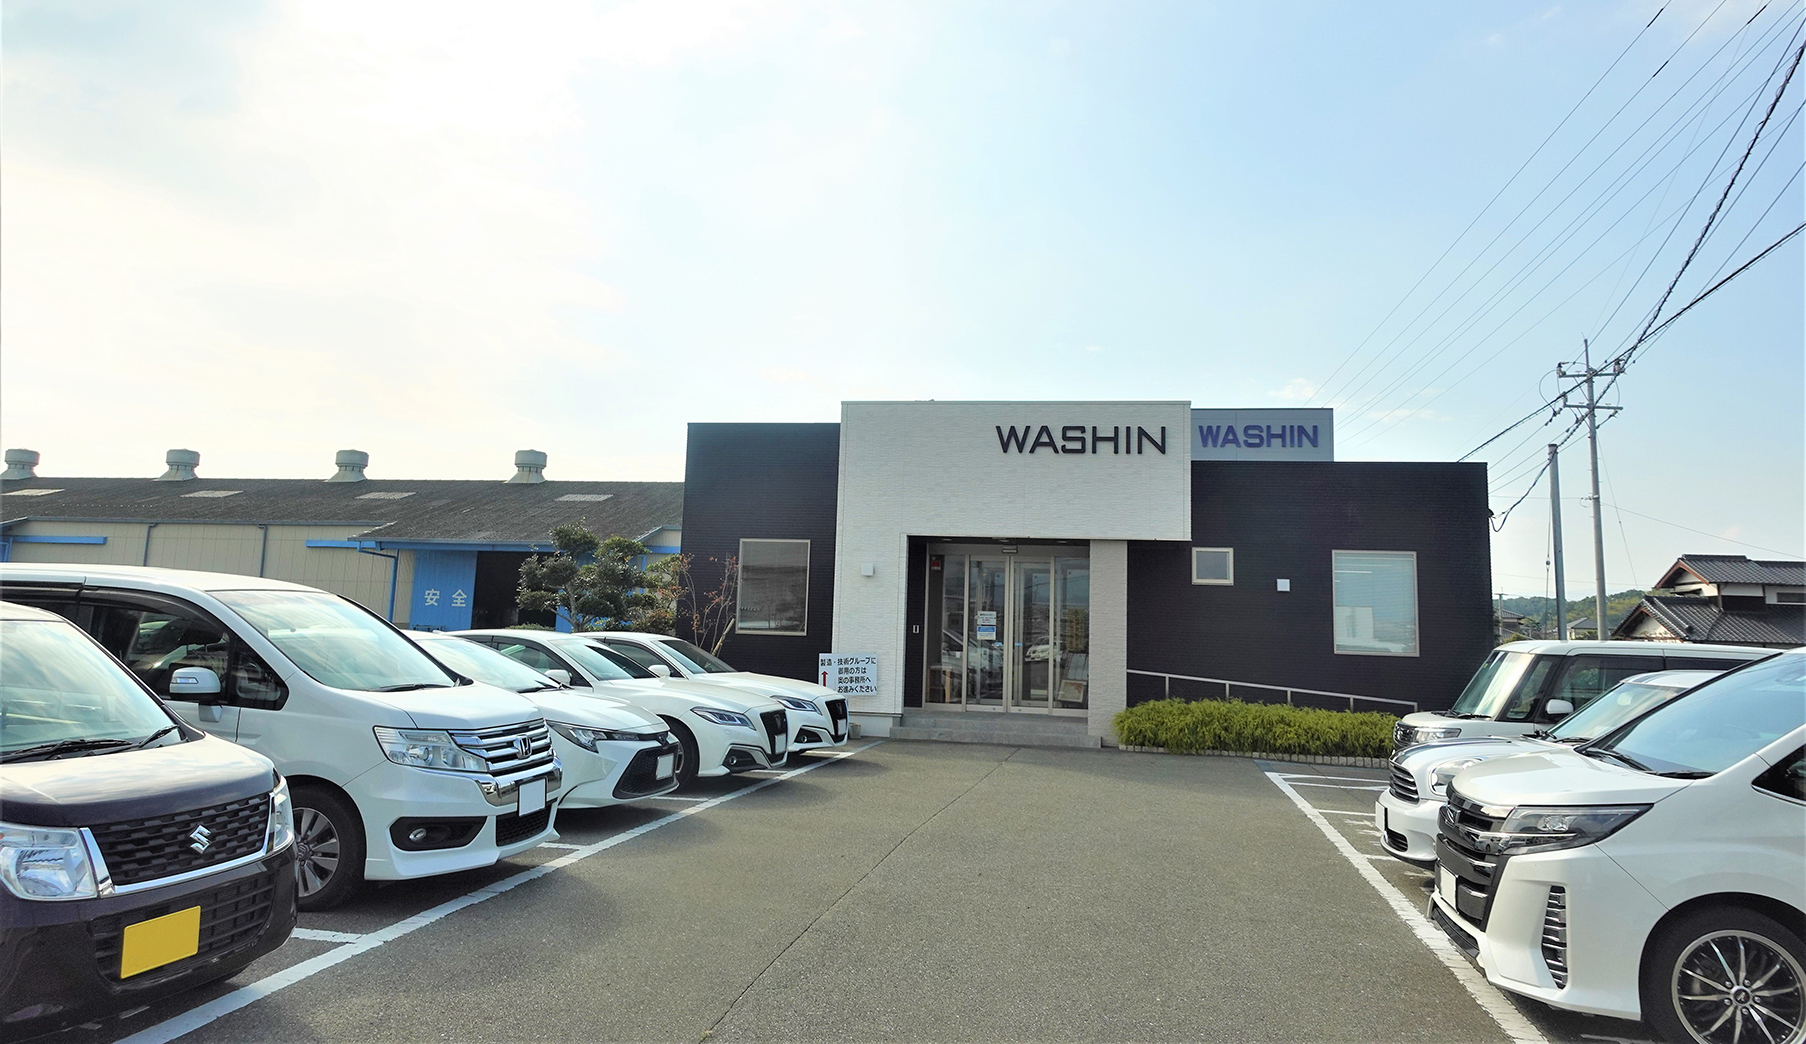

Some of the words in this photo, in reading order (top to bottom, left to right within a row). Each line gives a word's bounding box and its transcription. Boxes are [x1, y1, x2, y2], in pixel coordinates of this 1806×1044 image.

[995, 425, 1167, 455] WASHIN
[1198, 424, 1319, 448] WASHIN
[424, 588, 468, 607] 安全
[837, 685, 878, 694] お進みください
